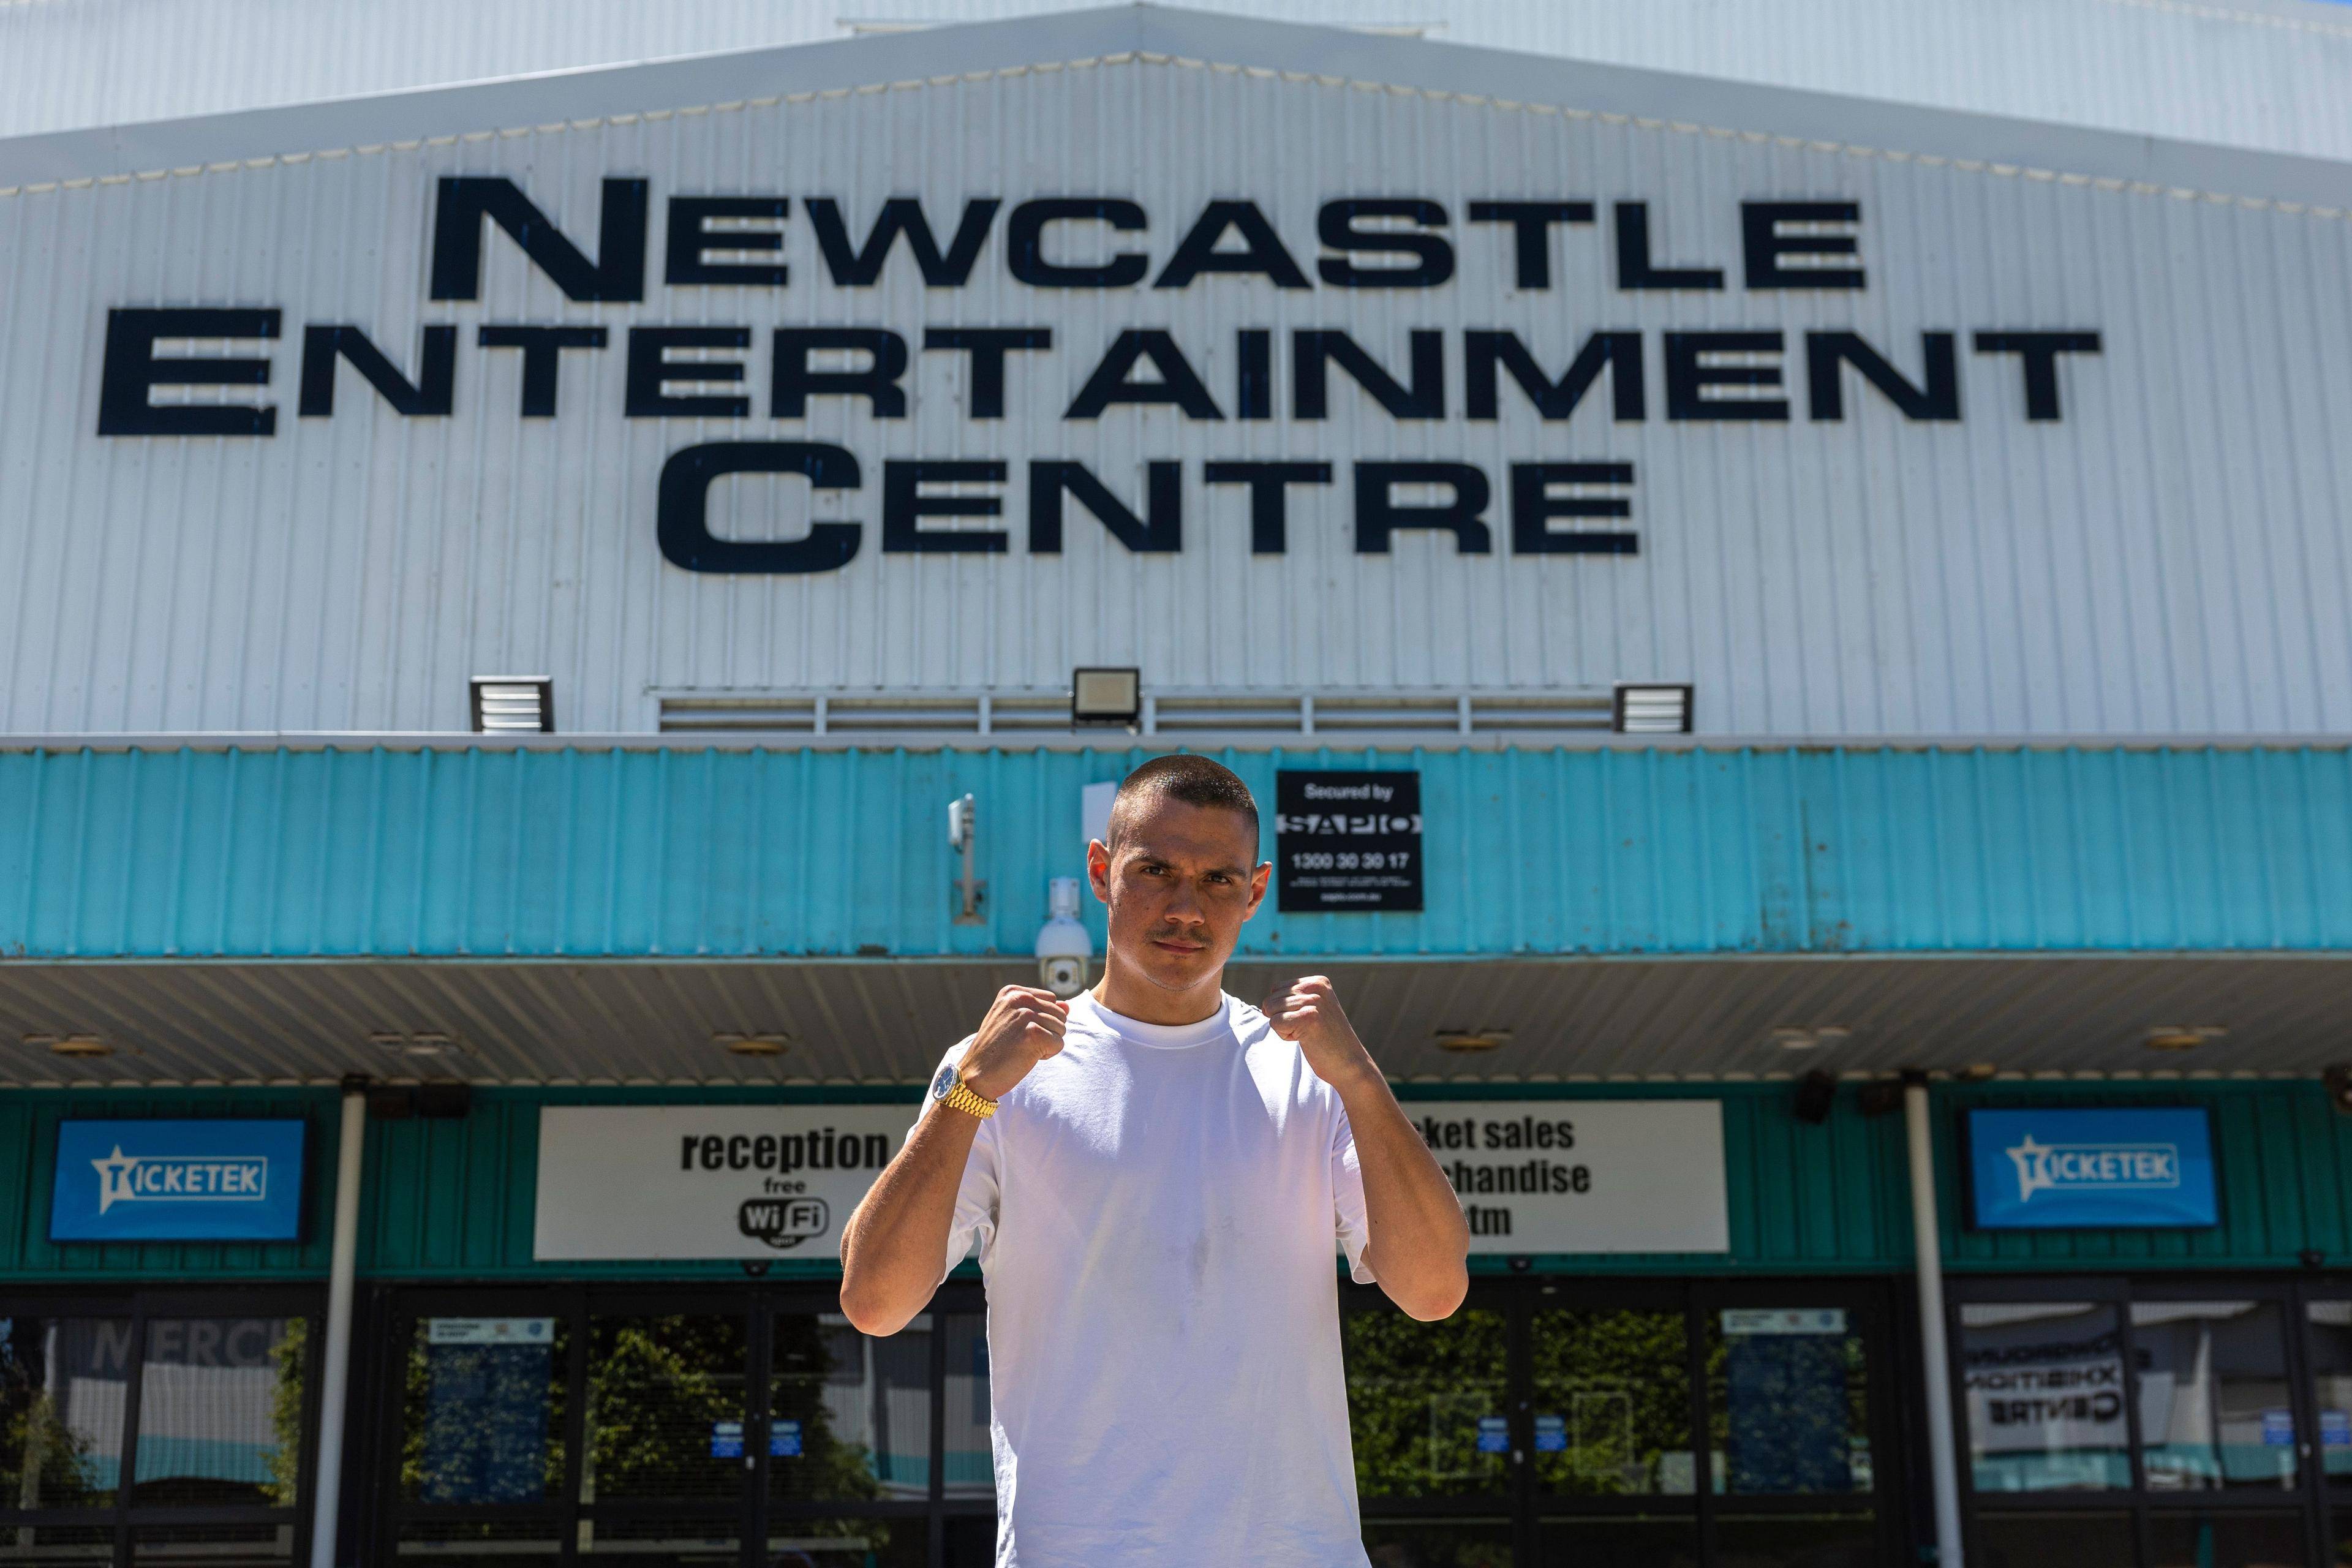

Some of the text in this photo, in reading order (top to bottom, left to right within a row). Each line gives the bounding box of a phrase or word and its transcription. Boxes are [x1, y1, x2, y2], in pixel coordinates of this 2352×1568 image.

[430, 176, 1866, 303] NEWCASTLE
[97, 307, 2102, 437] ENTERTAINMENT
[657, 440, 1638, 575] CENTRE
[1304, 783, 1394, 802] Secured by
[1276, 814, 1422, 834] SAPIO
[1291, 852, 1409, 870] 1300 30 30 17
[1483, 1115, 1576, 1150] sales
[680, 1126, 889, 1175] reception
[2023, 1152, 2173, 1180] TICKETEK
[107, 1164, 260, 1193] TICKETEK
[763, 1176, 807, 1194] free
[1466, 1204, 1513, 1237] tm
